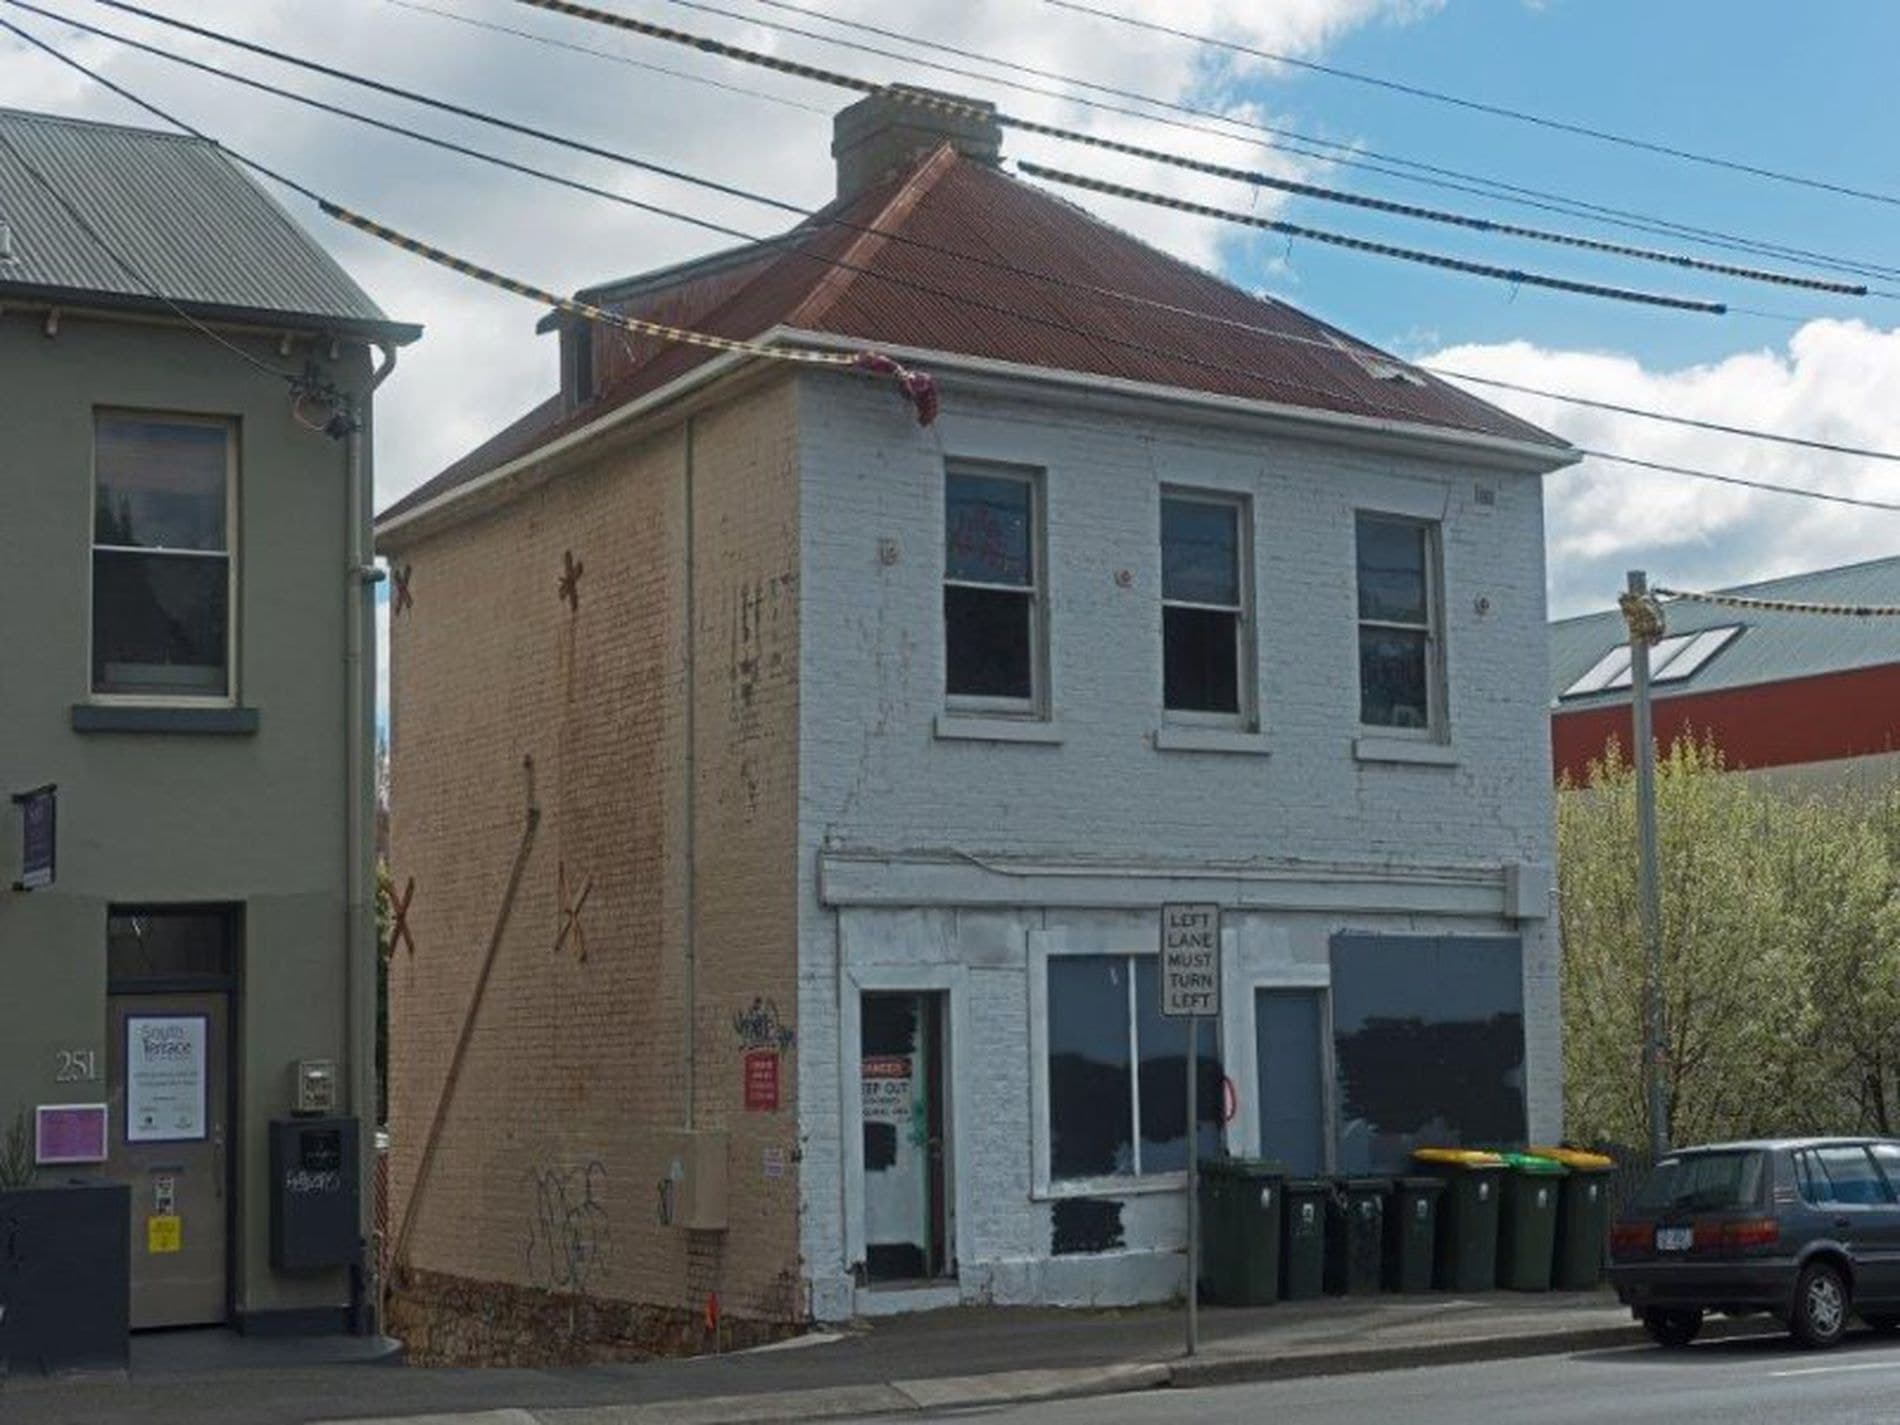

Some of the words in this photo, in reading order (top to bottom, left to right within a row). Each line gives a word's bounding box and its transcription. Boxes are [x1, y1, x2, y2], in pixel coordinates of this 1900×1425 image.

[1171, 914, 1209, 927] LEFT
[1169, 933, 1213, 948] LANE
[1169, 954, 1212, 967] MUST
[1170, 973, 1213, 988] TURN
[1172, 992, 1210, 1008] LEFT
[143, 1038, 192, 1056] Terrace
[55, 1050, 96, 1083] 251
[884, 1082, 910, 1094] OUT
